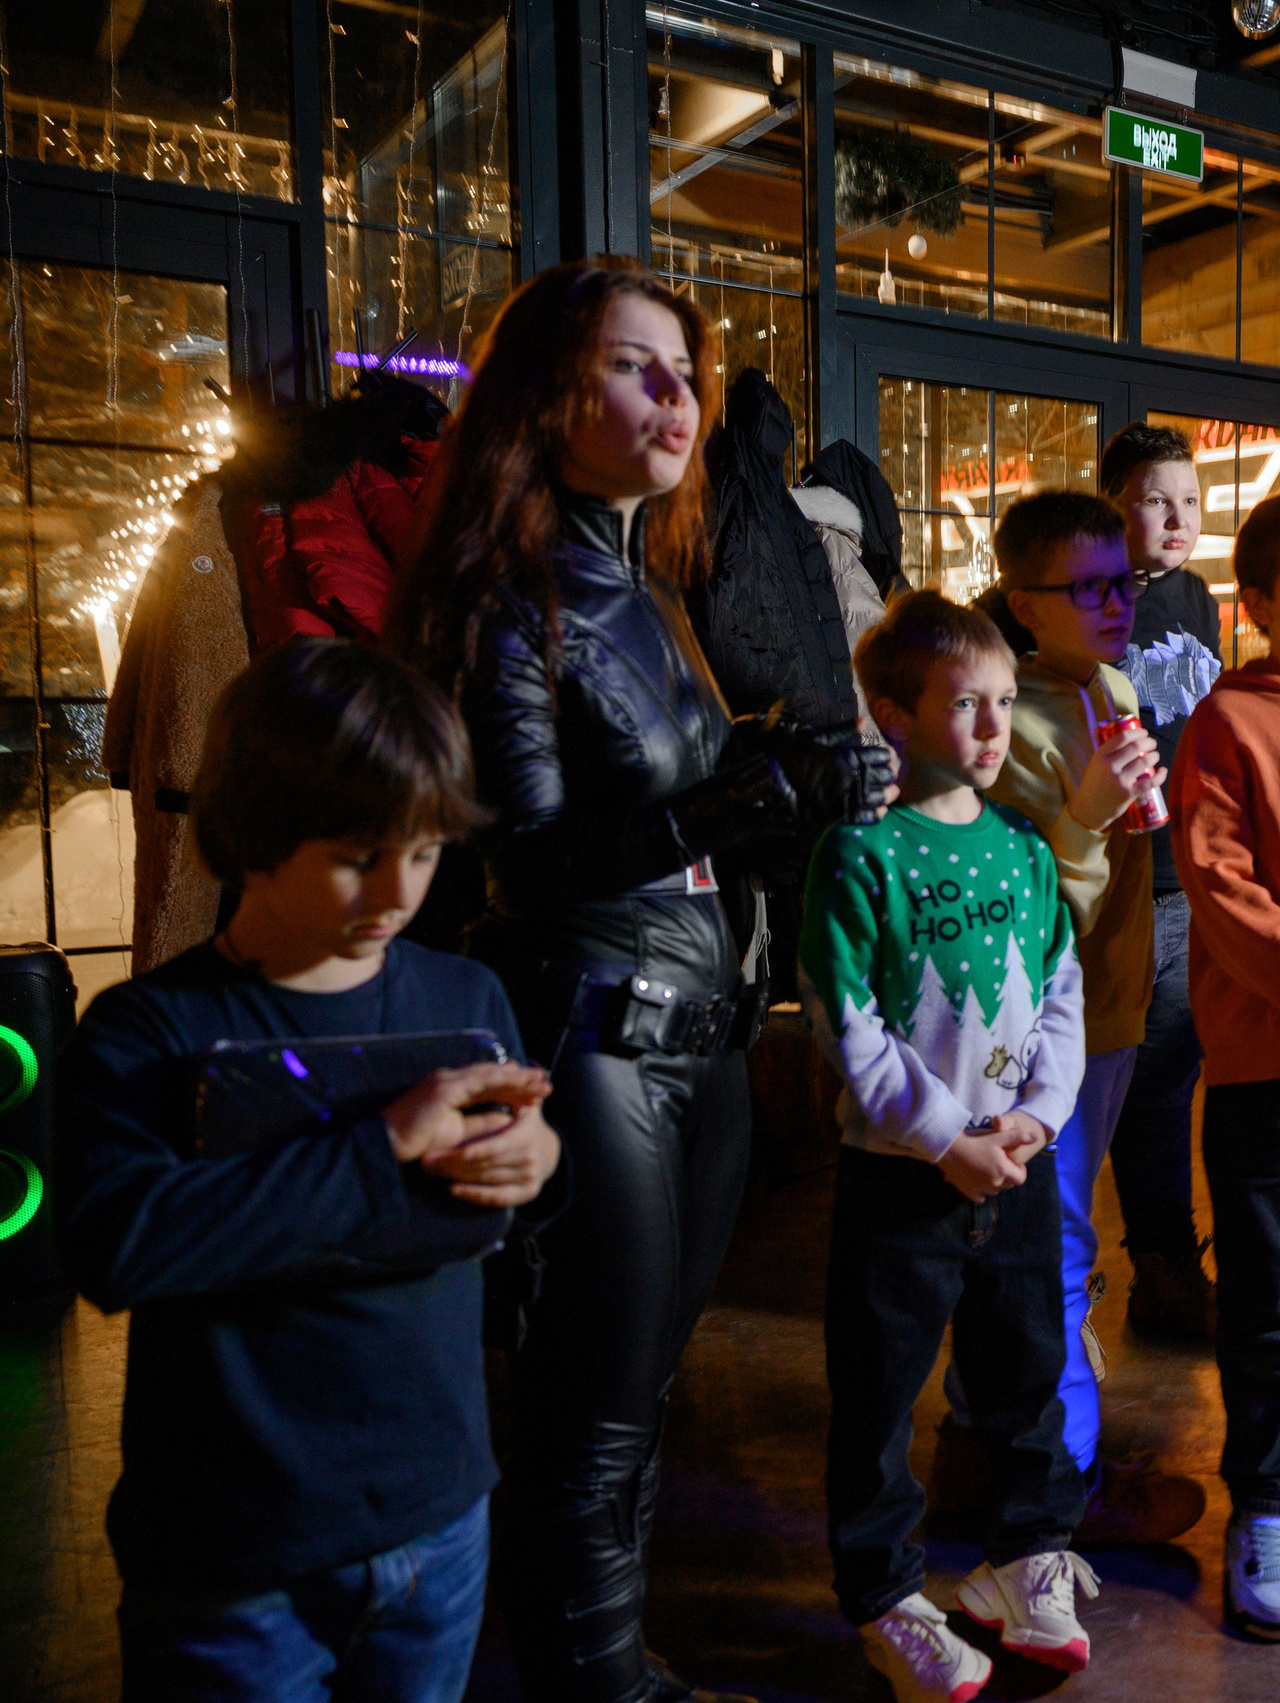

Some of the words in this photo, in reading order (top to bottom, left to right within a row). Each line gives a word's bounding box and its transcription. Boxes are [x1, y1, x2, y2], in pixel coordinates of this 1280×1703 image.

[1133, 123, 1178, 161] ВЫХОД
[1143, 147, 1168, 171] EXIT
[907, 879, 962, 915] HO
[909, 916, 962, 945] HO
[963, 893, 1016, 930] HO!
